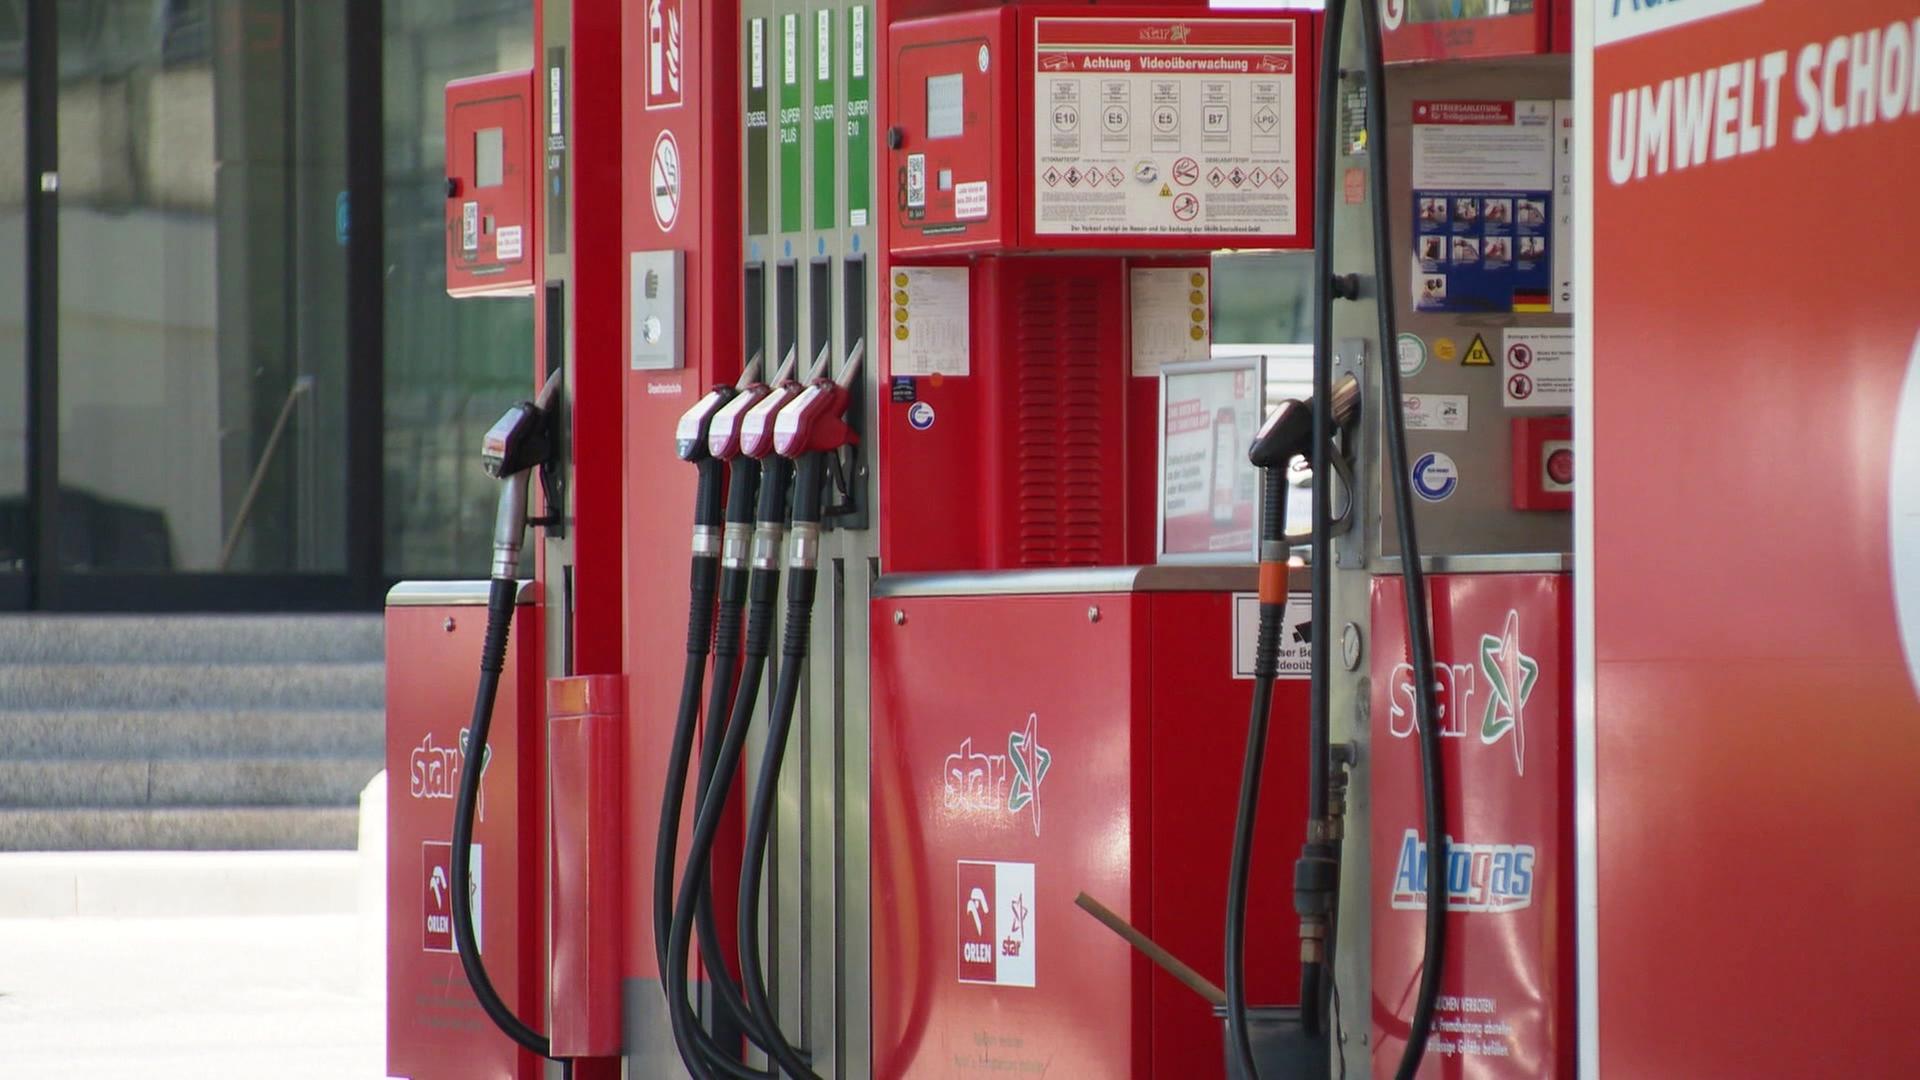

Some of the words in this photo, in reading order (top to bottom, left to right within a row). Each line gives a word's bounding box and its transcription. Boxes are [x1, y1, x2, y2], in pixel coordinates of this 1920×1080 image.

[1083, 56, 1131, 71] Achtung
[1139, 56, 1249, 71] Videoüberwachung
[781, 107, 800, 124] SUPER
[813, 104, 834, 120] SUPER
[848, 100, 869, 117] SUPER
[745, 111, 768, 127] DIESEL
[1055, 112, 1076, 124] E10
[1108, 112, 1123, 124] E5
[1158, 112, 1173, 124] E5
[1208, 113, 1224, 125] B7
[1257, 115, 1275, 124] LPG
[1609, 49, 1789, 185] UMWELT
[780, 127, 797, 143] PLUS
[848, 120, 859, 136] E10
[1472, 349, 1484, 360] EX
[1390, 663, 1475, 738] sar
[411, 732, 457, 798] star
[944, 736, 1006, 810] star
[427, 915, 449, 934] ORLEN
[963, 942, 992, 964] ORLEN
[1002, 935, 1021, 957] star
